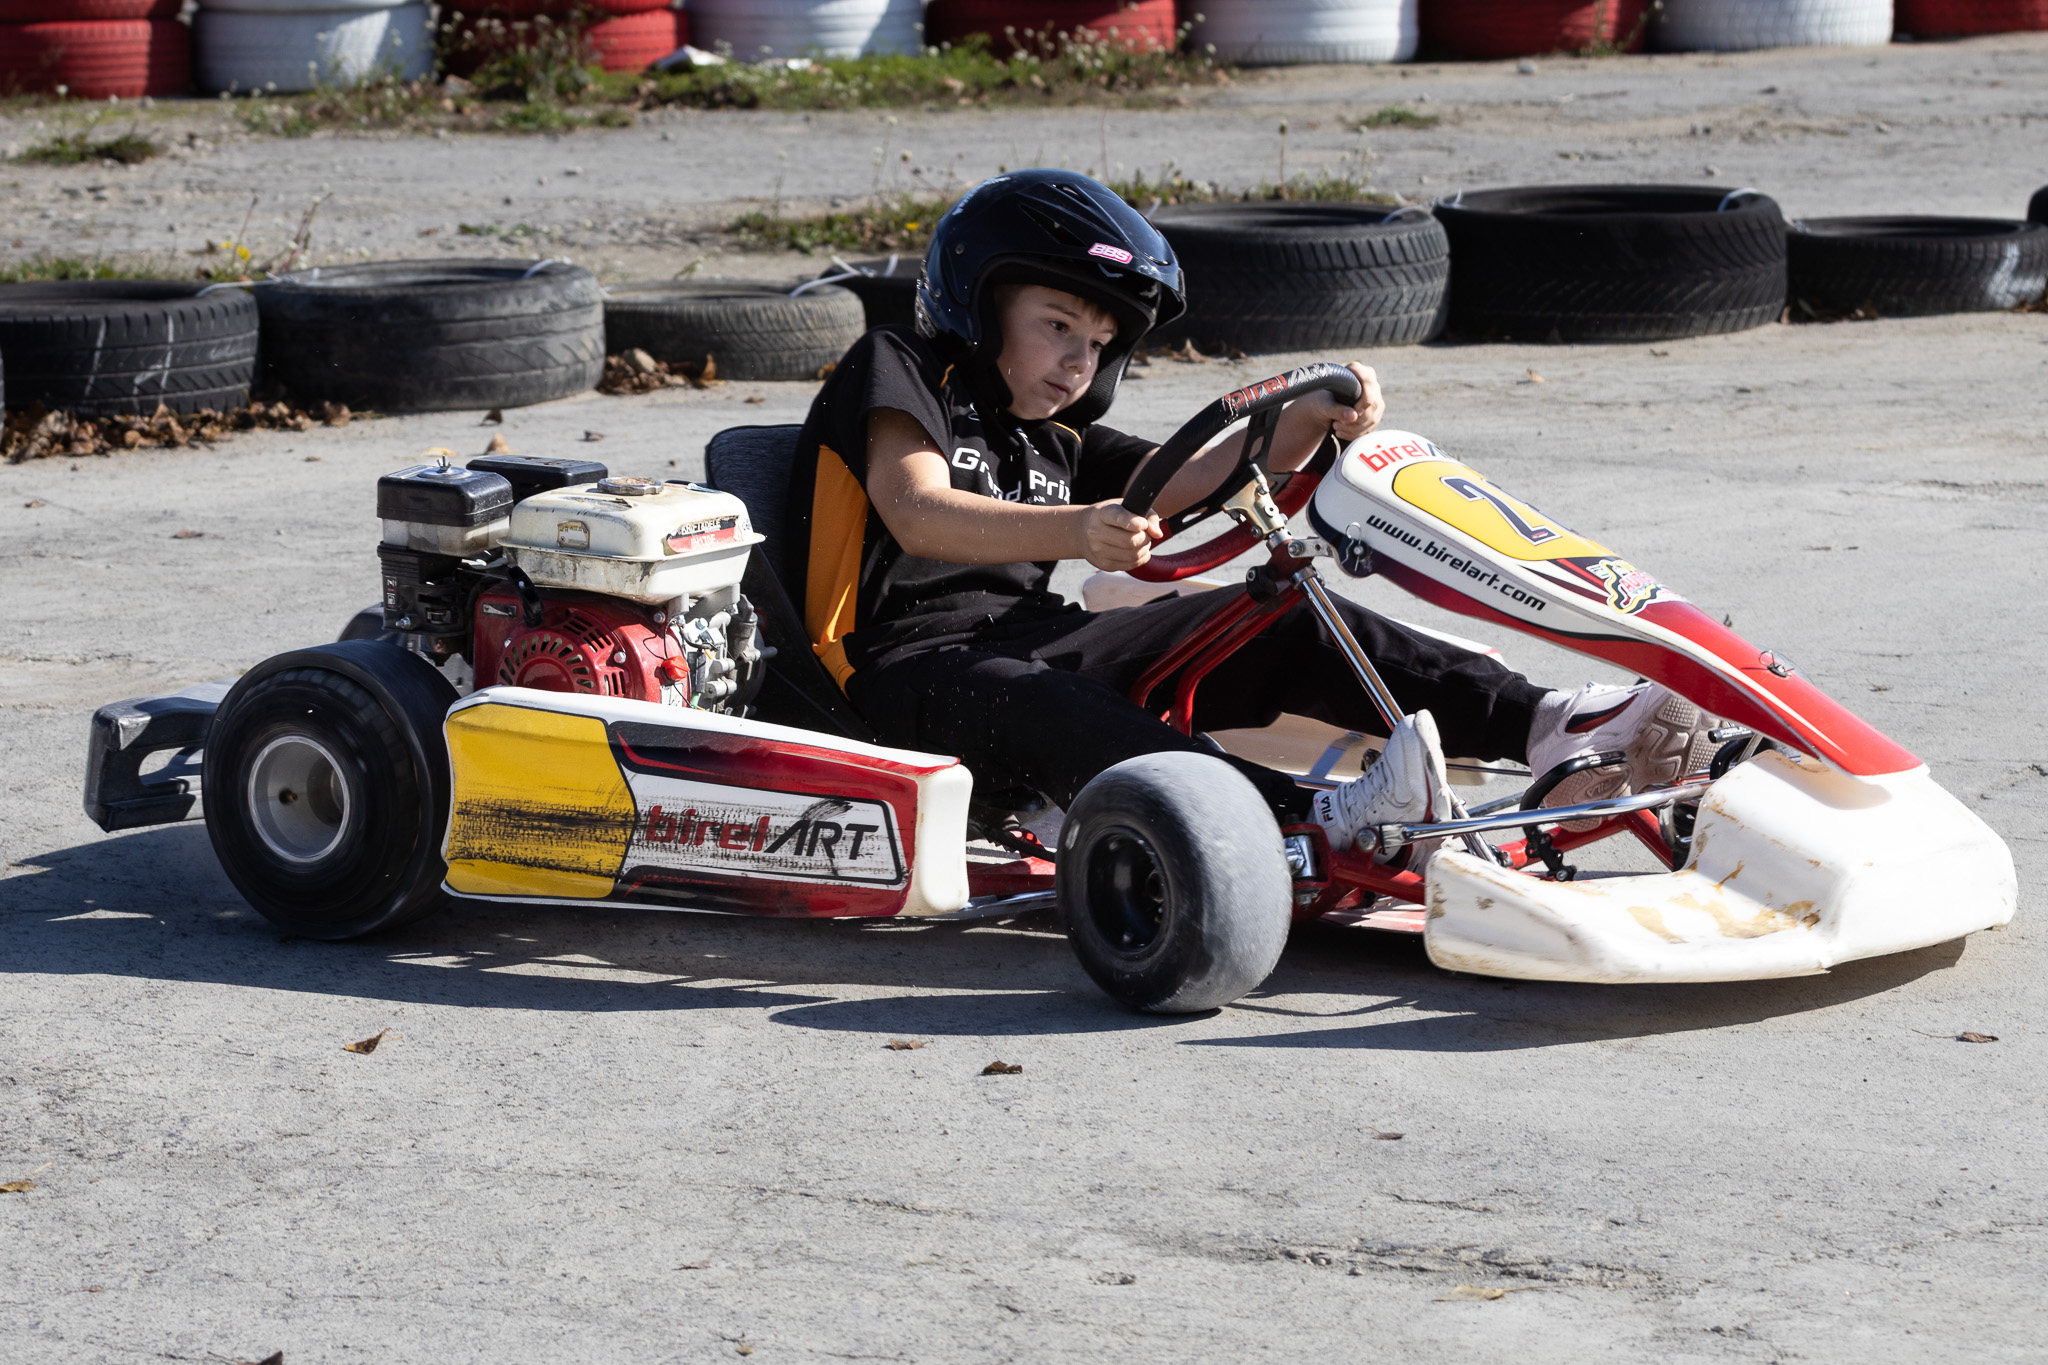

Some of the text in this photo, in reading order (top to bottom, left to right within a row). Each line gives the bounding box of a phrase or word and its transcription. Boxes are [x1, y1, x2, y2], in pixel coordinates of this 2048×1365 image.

[1092, 242, 1132, 263] BBS
[1365, 514, 1547, 612] www.birelart.com
[1320, 795, 1334, 822] FILA
[644, 805, 880, 861] birelART
